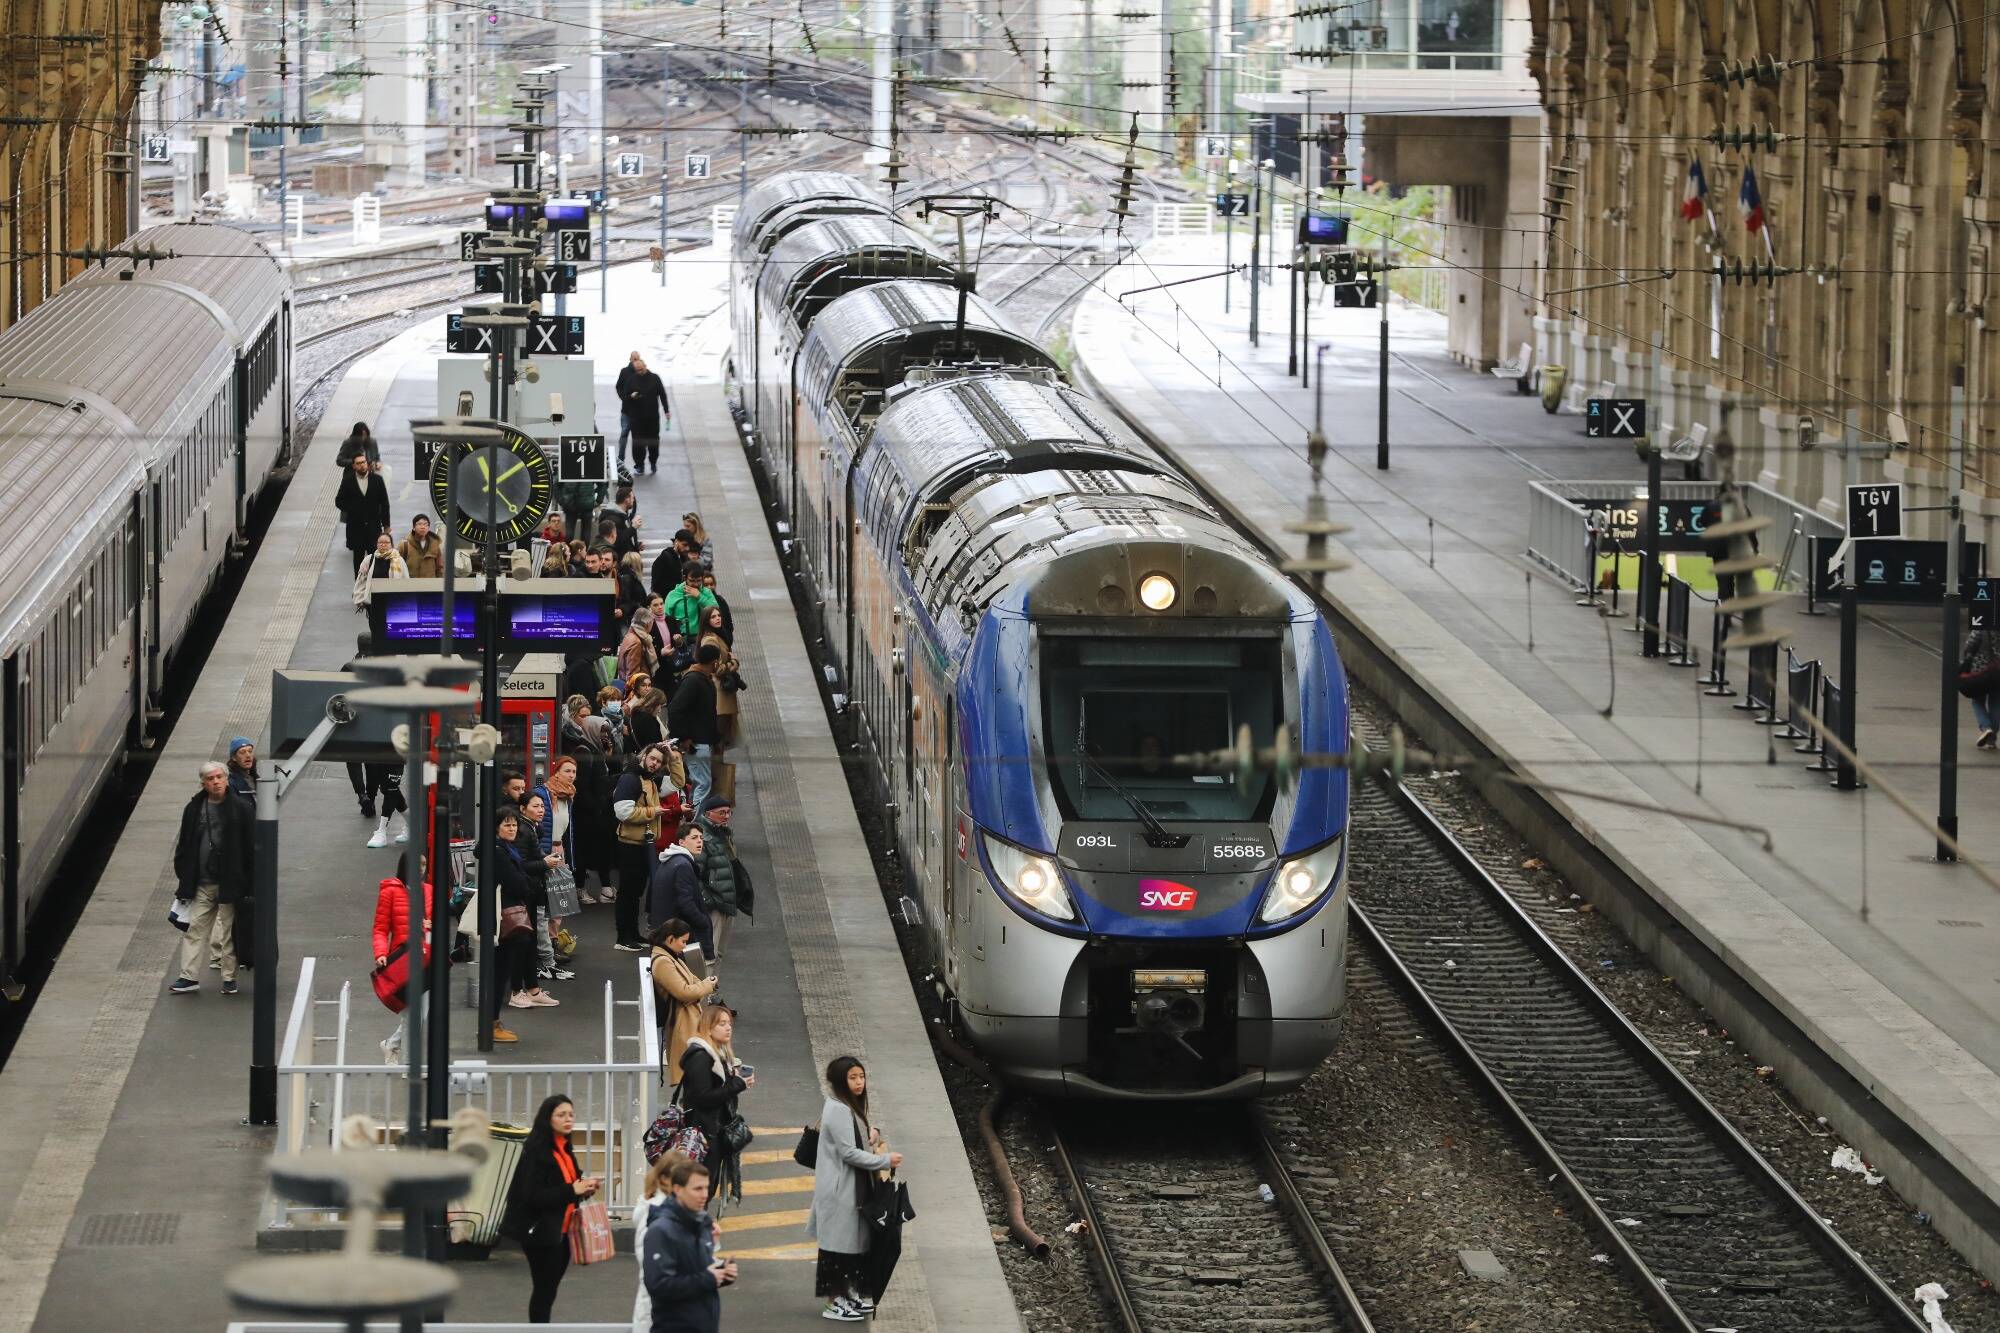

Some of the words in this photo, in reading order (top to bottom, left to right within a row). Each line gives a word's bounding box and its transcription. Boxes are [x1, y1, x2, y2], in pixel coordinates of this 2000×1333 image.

[154, 148, 161, 158] 2
[626, 163, 635, 174] 2
[693, 165, 702, 176] 2
[1231, 199, 1245, 216] Z
[541, 271, 557, 292] Y
[1355, 286, 1371, 306] Y
[474, 327, 492, 351] X
[535, 325, 558, 352] X
[1592, 406, 1599, 415] A
[1612, 408, 1636, 434] X
[569, 439, 596, 453] TGV
[576, 455, 585, 476] 1
[1858, 490, 1891, 506] TGV
[1867, 509, 1878, 532] 1
[1905, 567, 1915, 581] B
[1977, 588, 1987, 598] A
[503, 680, 545, 691] selecta
[1076, 836, 1117, 848] 093L
[1213, 845, 1266, 858] 55685
[1140, 891, 1194, 907] SNCF
